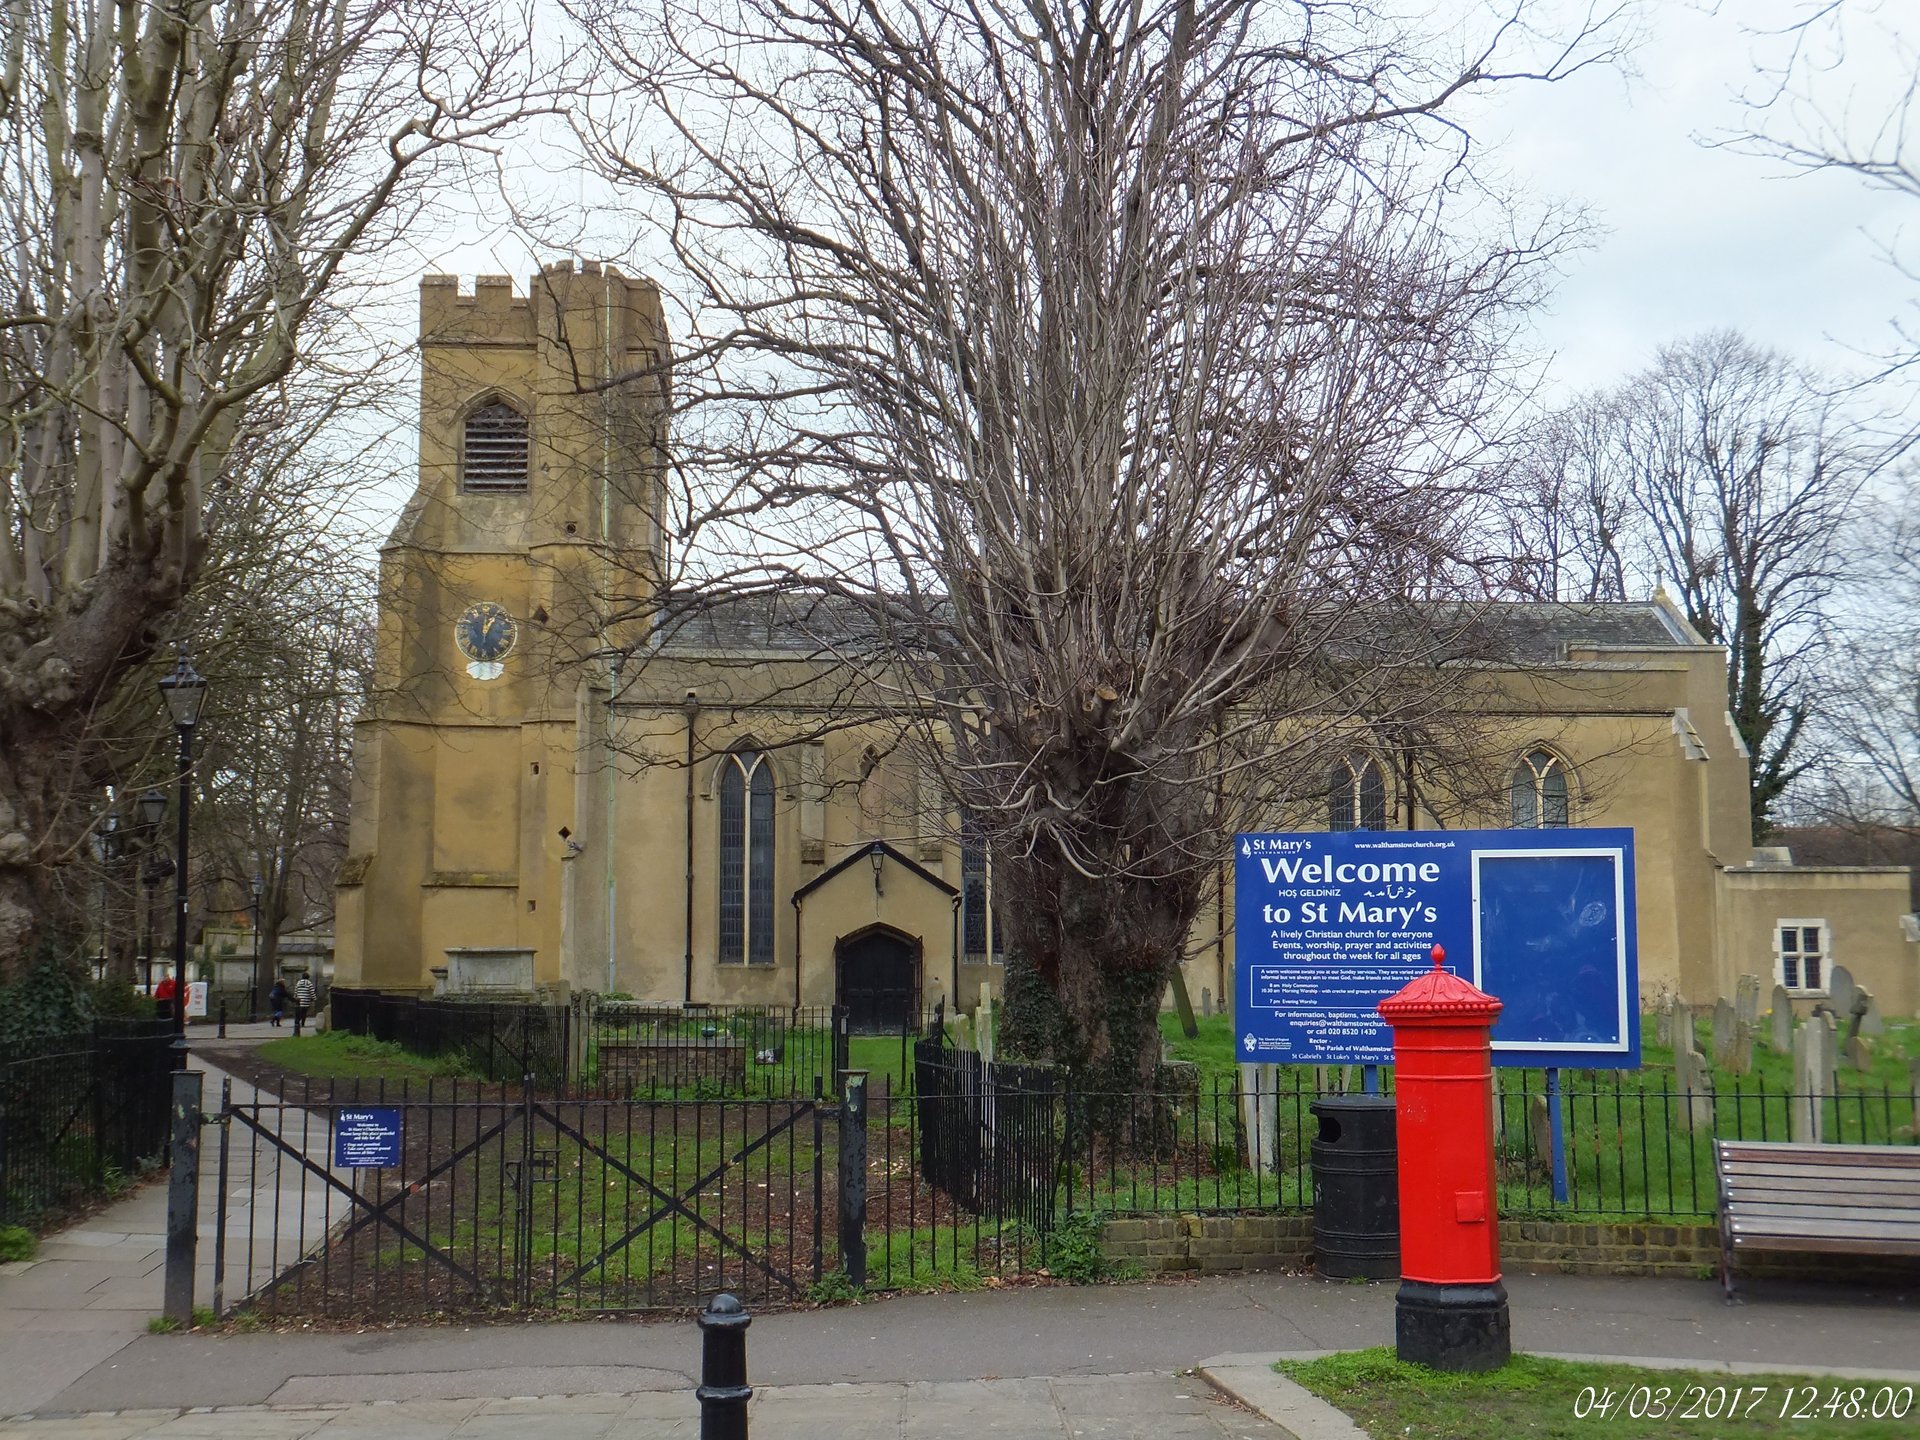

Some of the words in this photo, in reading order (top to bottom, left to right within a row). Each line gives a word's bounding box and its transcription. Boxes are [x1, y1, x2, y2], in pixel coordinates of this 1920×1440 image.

[1253, 839, 1265, 850] St
[1270, 839, 1312, 853] Mary's
[1355, 841, 1455, 849] www.walthamstowchurch.org.uk
[1261, 855, 1440, 884] Welcome
[1279, 889, 1297, 898] HOŞ
[1300, 886, 1341, 897] GELDİNİZ
[1263, 904, 1291, 924] to
[1301, 902, 1328, 924] St
[1338, 901, 1438, 929] Mary's
[1271, 930, 1278, 938] A
[1280, 930, 1302, 940] lively
[1305, 930, 1343, 938] Christian
[1345, 930, 1374, 938] church
[1376, 930, 1389, 938] for
[1391, 932, 1433, 940] everyone
[1272, 941, 1303, 949] Events,
[1305, 941, 1342, 951] worship,
[1345, 943, 1373, 951] prayer
[1375, 941, 1391, 949] and
[1393, 941, 1431, 949] activities
[1283, 952, 1331, 962] throughout
[1333, 952, 1347, 960] the
[1349, 952, 1373, 960] week
[1375, 952, 1388, 960] for
[1390, 952, 1400, 960] all
[1402, 954, 1421, 962] ages
[1288, 1011, 1327, 1019] information,
